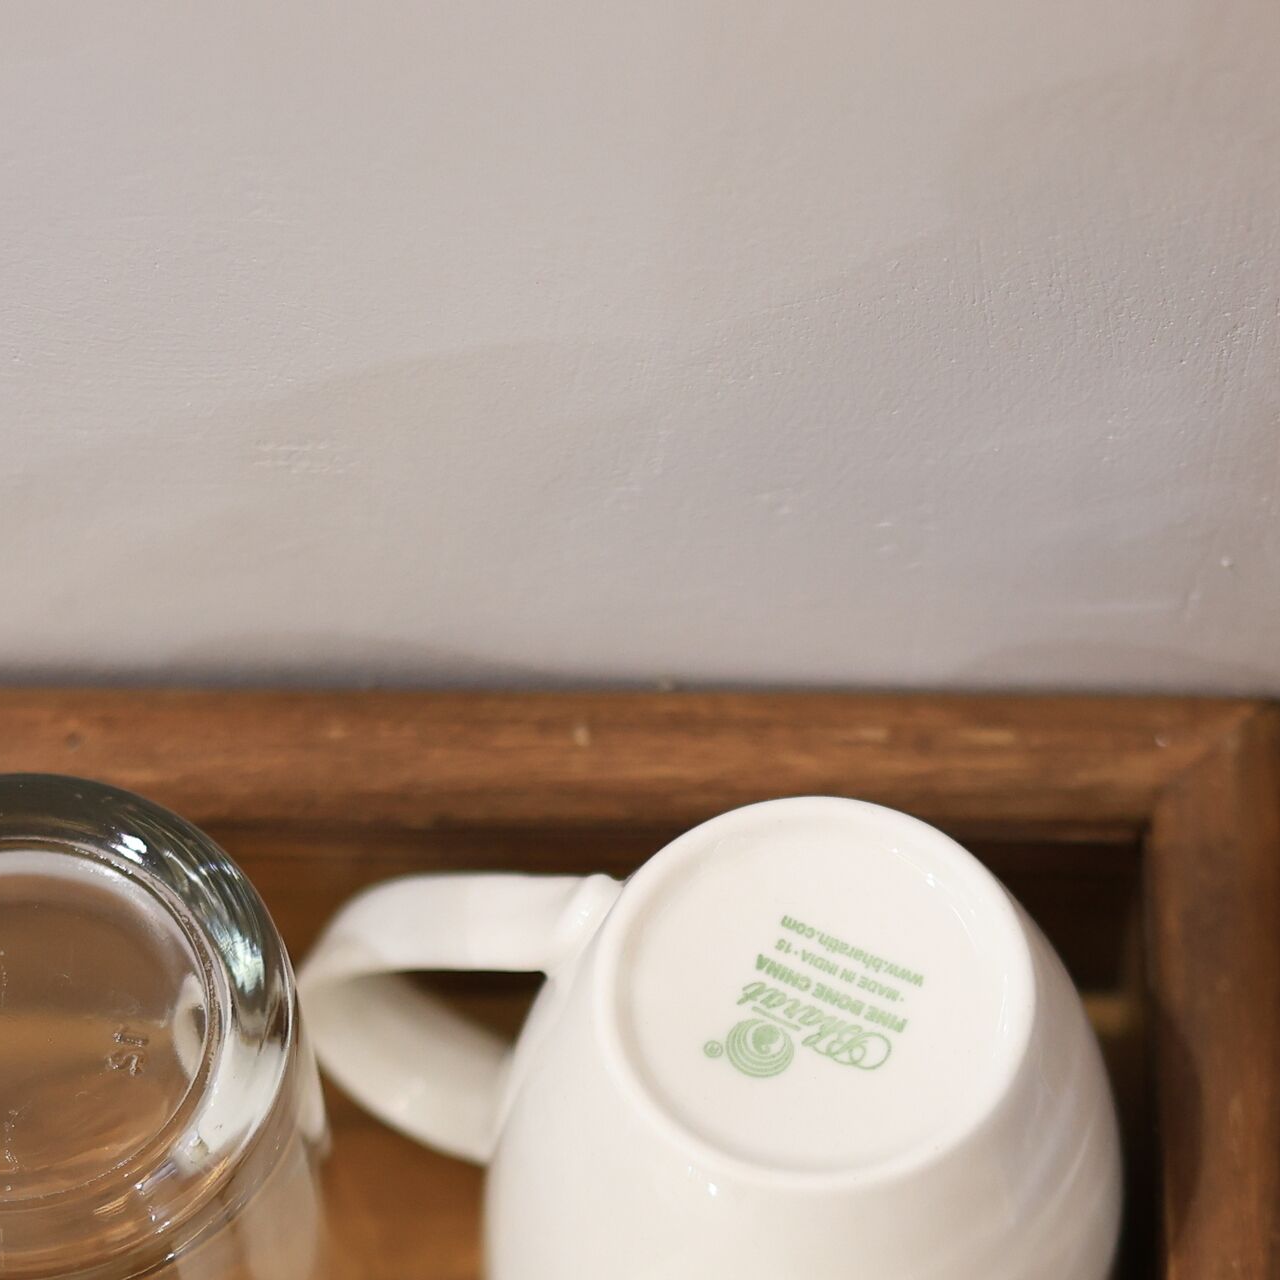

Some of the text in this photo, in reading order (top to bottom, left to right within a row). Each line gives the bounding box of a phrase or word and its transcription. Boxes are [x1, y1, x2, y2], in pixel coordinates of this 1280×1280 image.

[781, 915, 924, 987] www.bharatin.com
[801, 949, 839, 975] INDIA
[840, 969, 856, 982] IN
[756, 954, 907, 1032] FINE BONE CHINA
[857, 976, 897, 1001] MADE
[737, 981, 892, 1070] Bharat
